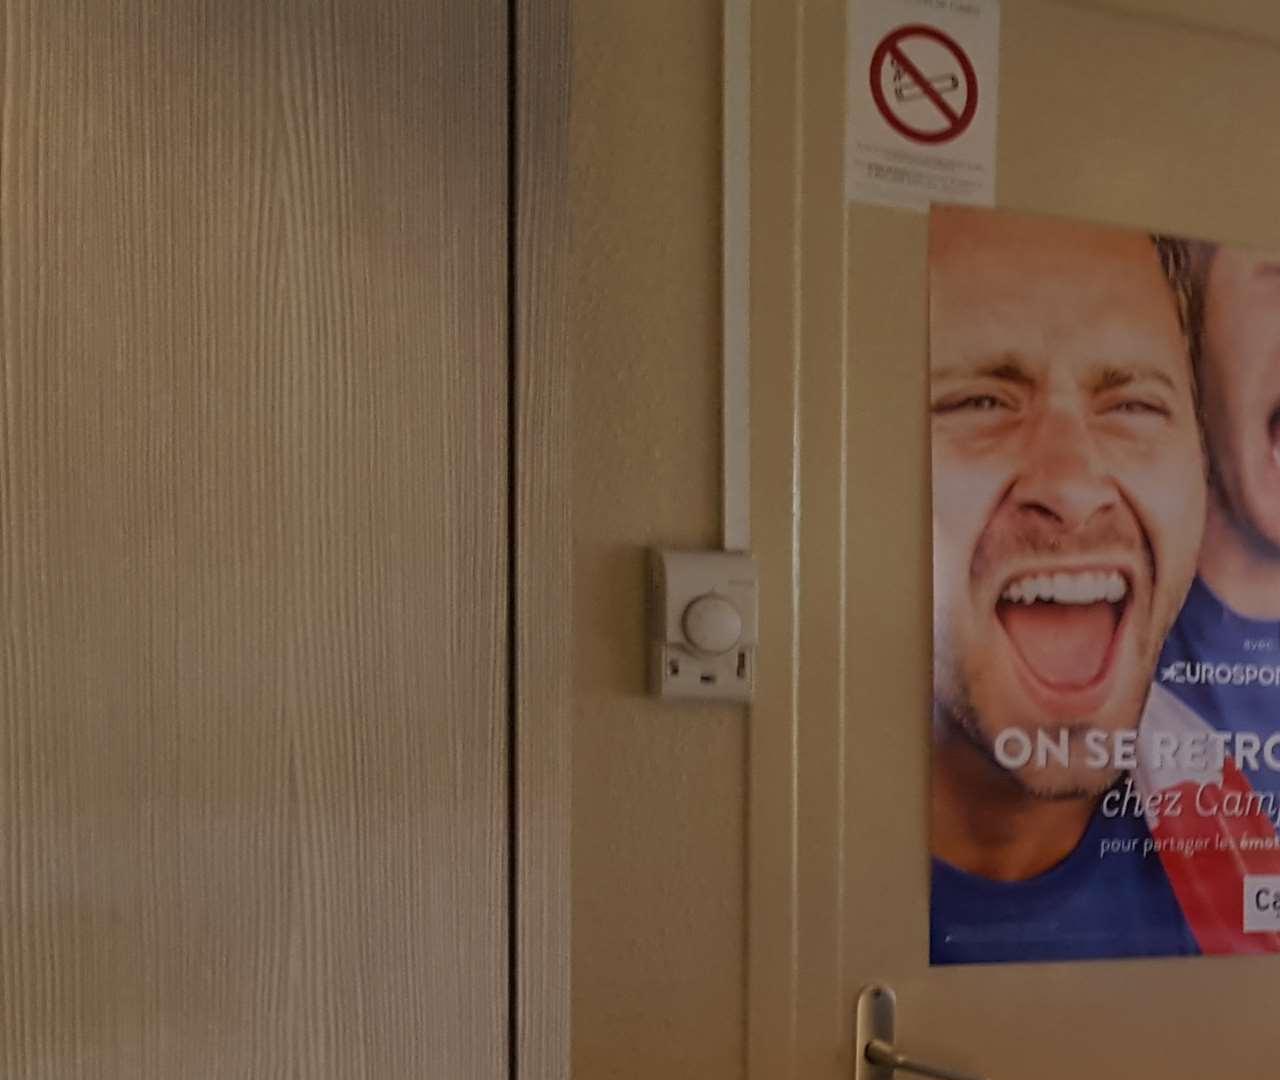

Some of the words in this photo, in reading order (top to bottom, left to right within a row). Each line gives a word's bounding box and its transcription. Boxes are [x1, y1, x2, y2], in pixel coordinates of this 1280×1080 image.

[1243, 639, 1274, 651] avec
[993, 727, 1071, 770] ON
[1084, 728, 1138, 770] SE
[1101, 778, 1183, 818] chez
[1100, 838, 1140, 860] pour
[1143, 836, 1210, 859] partager
[1215, 835, 1236, 851] les
